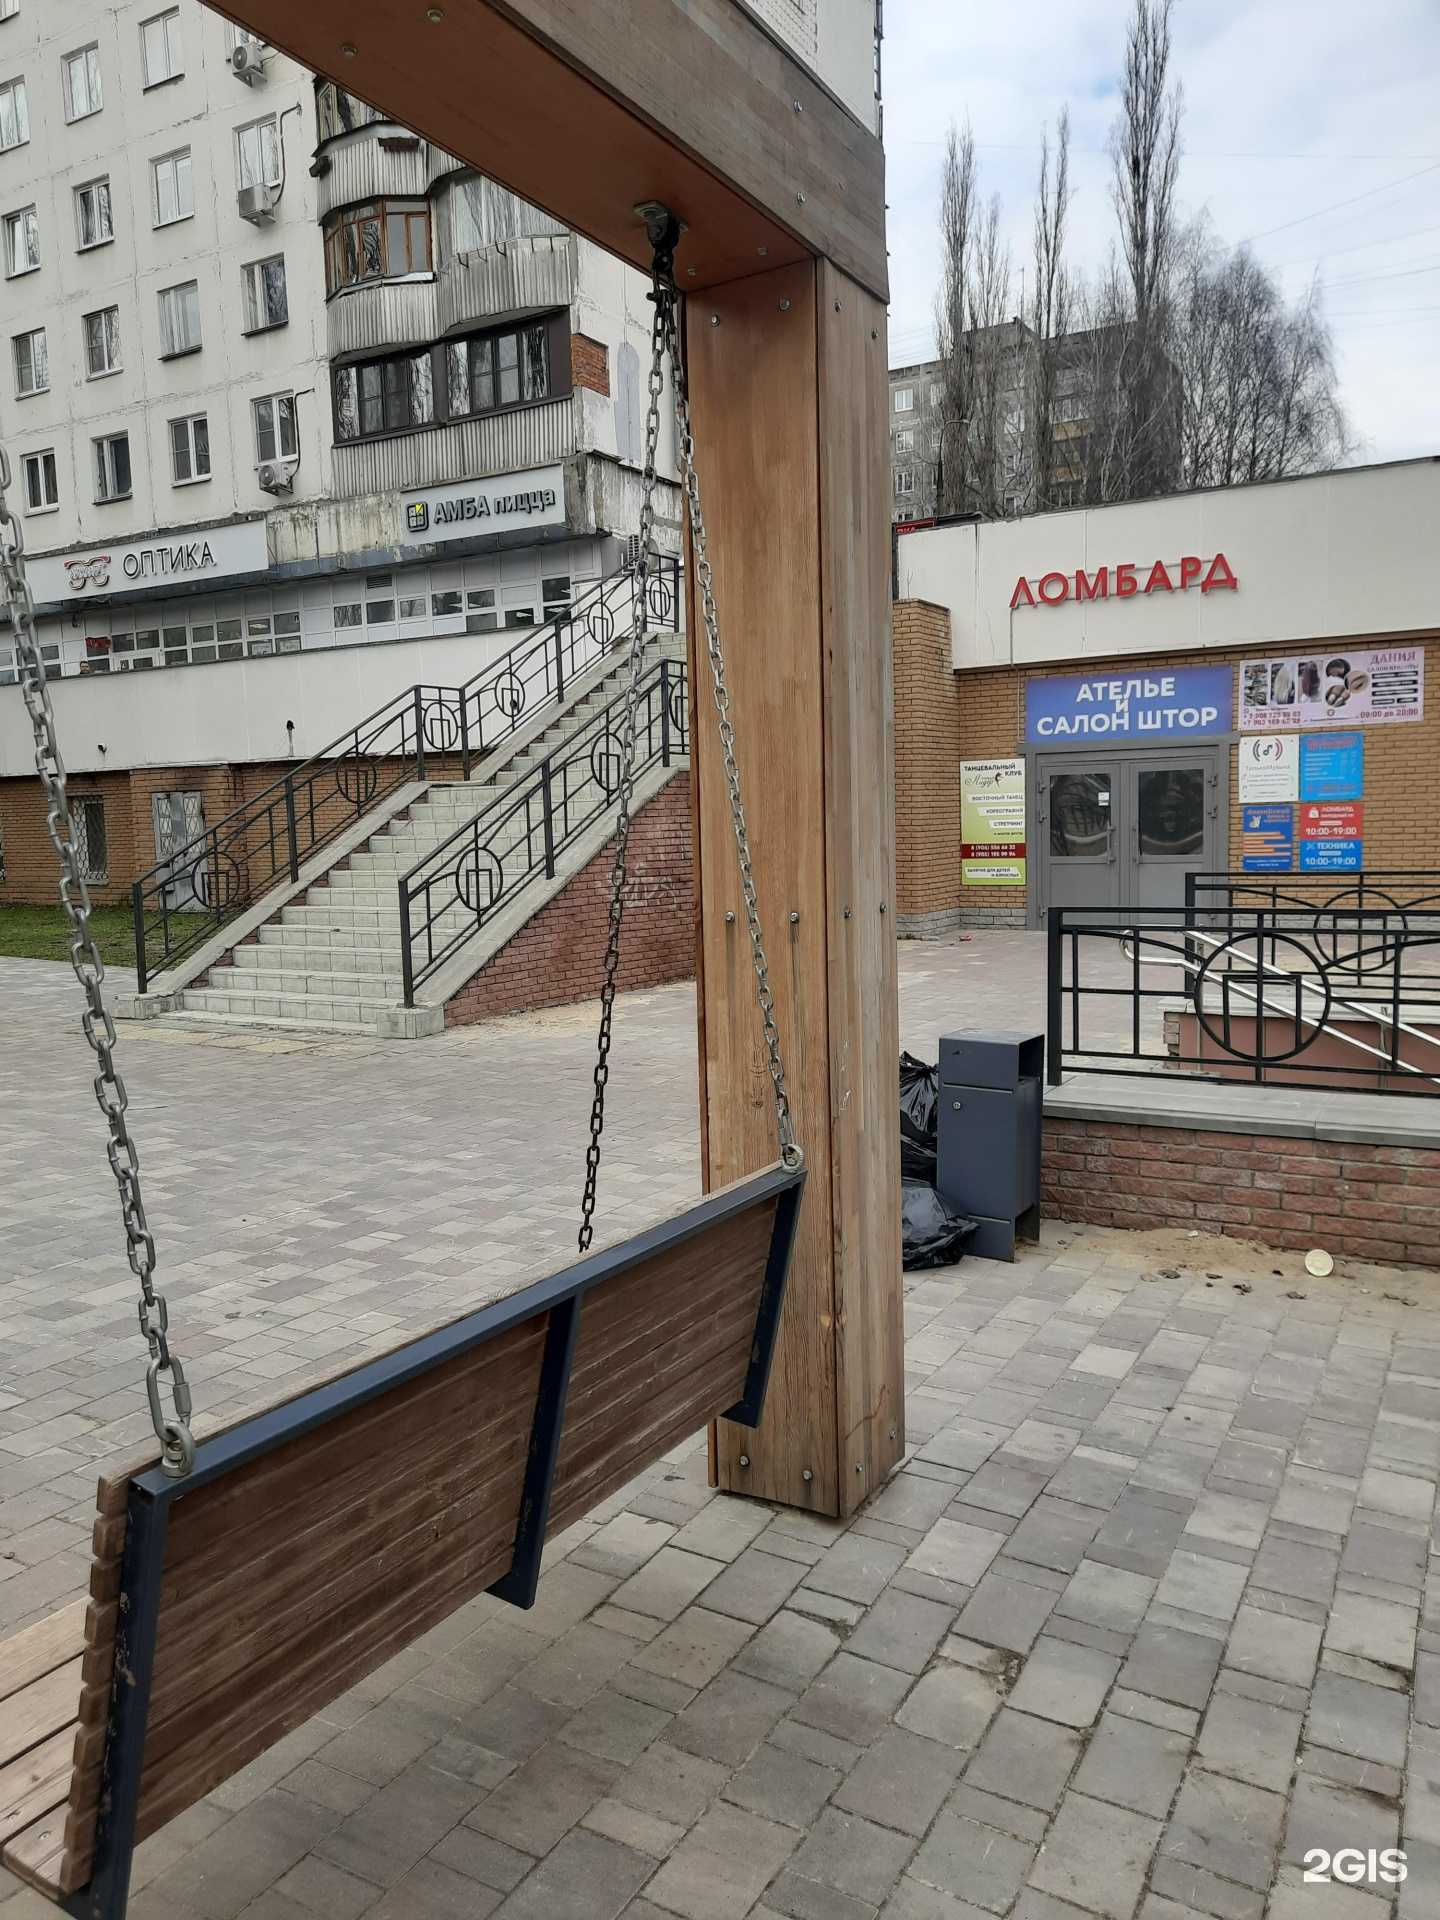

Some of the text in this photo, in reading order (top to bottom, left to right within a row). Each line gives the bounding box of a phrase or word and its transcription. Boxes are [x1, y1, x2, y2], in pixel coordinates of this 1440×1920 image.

[433, 494, 490, 525] АМБА
[493, 487, 556, 515] пицца
[122, 540, 216, 579] ОПТИКА
[1009, 553, 1240, 609] ЛОМБАРД
[1370, 650, 1417, 665] ДАНИЯ
[1075, 677, 1176, 703] АТЕЛЬЕ
[1115, 699, 1129, 713] И
[1036, 706, 1218, 736] САЛОН ШТОР
[963, 762, 1016, 771] ТАНЦЕВАЛЬНЫЙ
[1004, 769, 1023, 777] КЛУБ
[1317, 842, 1355, 850] ТЕХНИКА
